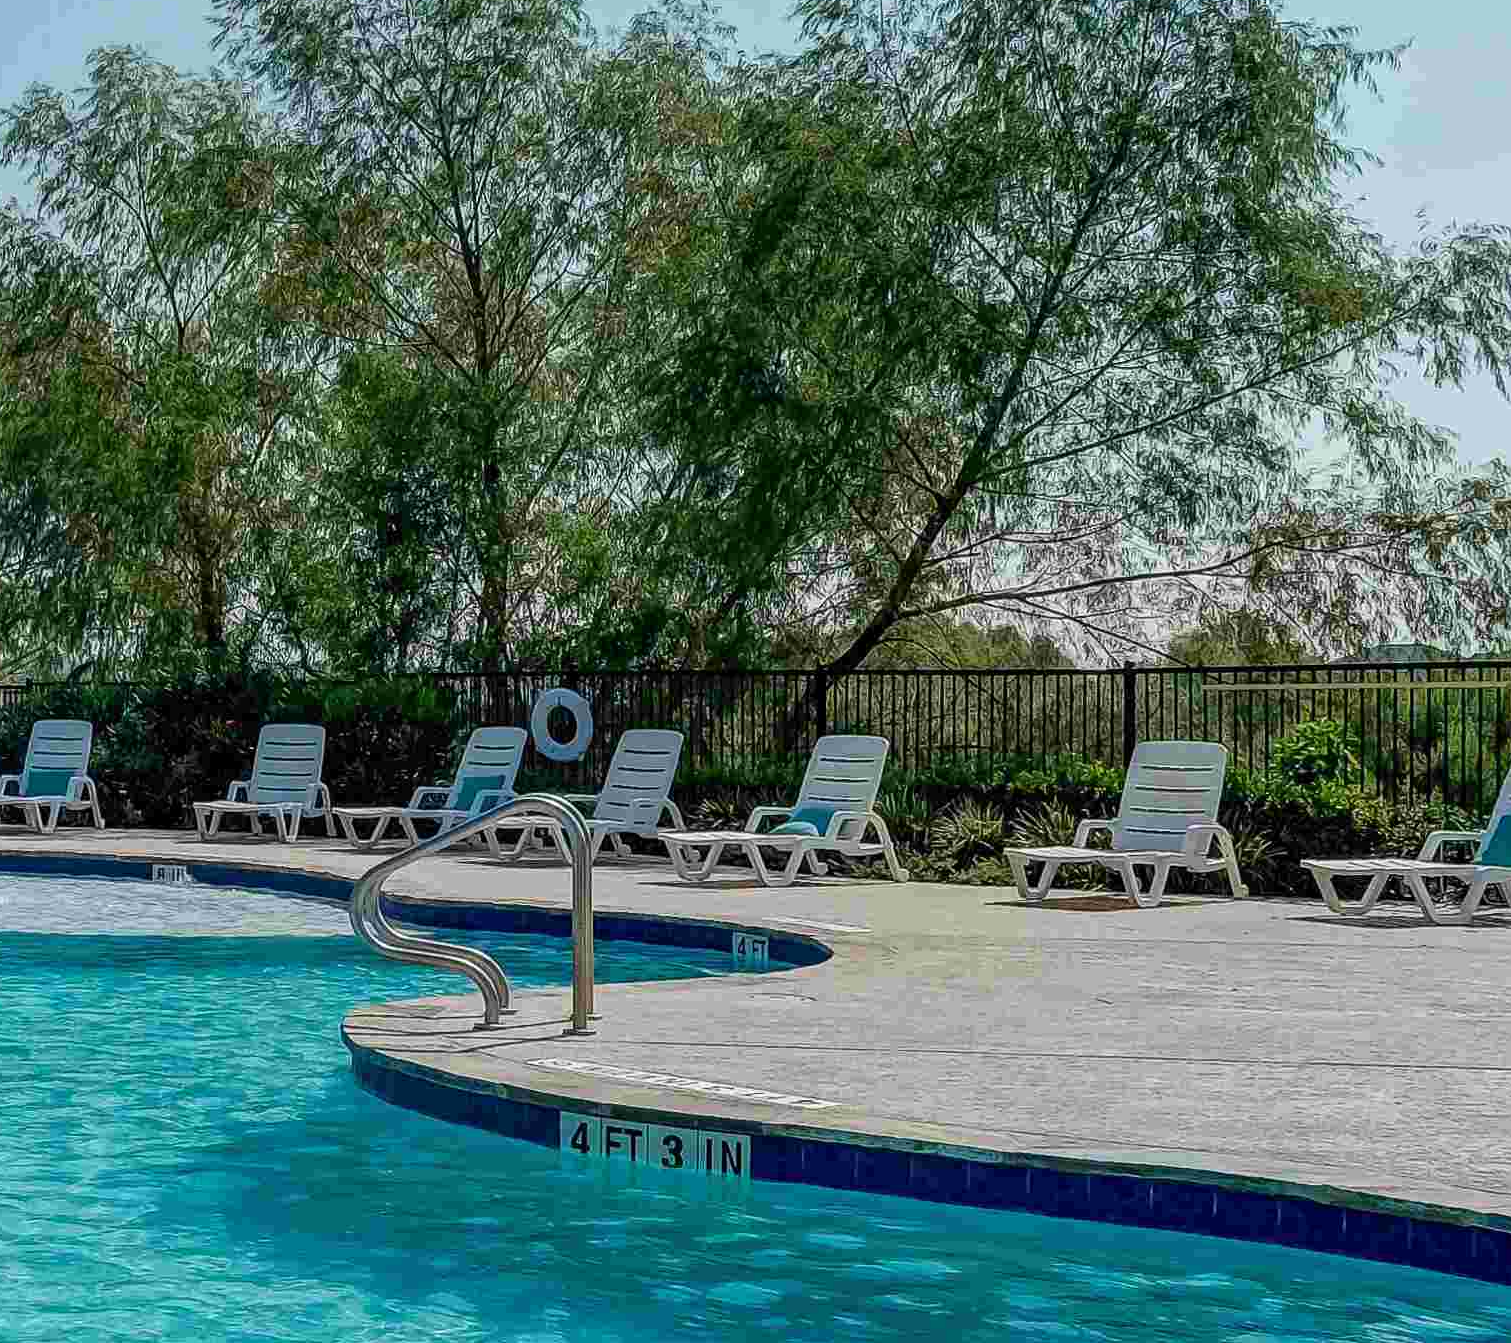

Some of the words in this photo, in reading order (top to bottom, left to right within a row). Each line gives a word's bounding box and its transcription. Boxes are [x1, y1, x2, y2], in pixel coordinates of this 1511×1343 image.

[737, 936, 747, 955] 4
[752, 939, 767, 961] FT
[570, 1122, 590, 1154] 4
[606, 1125, 643, 1162] FT
[661, 1135, 684, 1169] 3
[705, 1138, 742, 1176] IN
